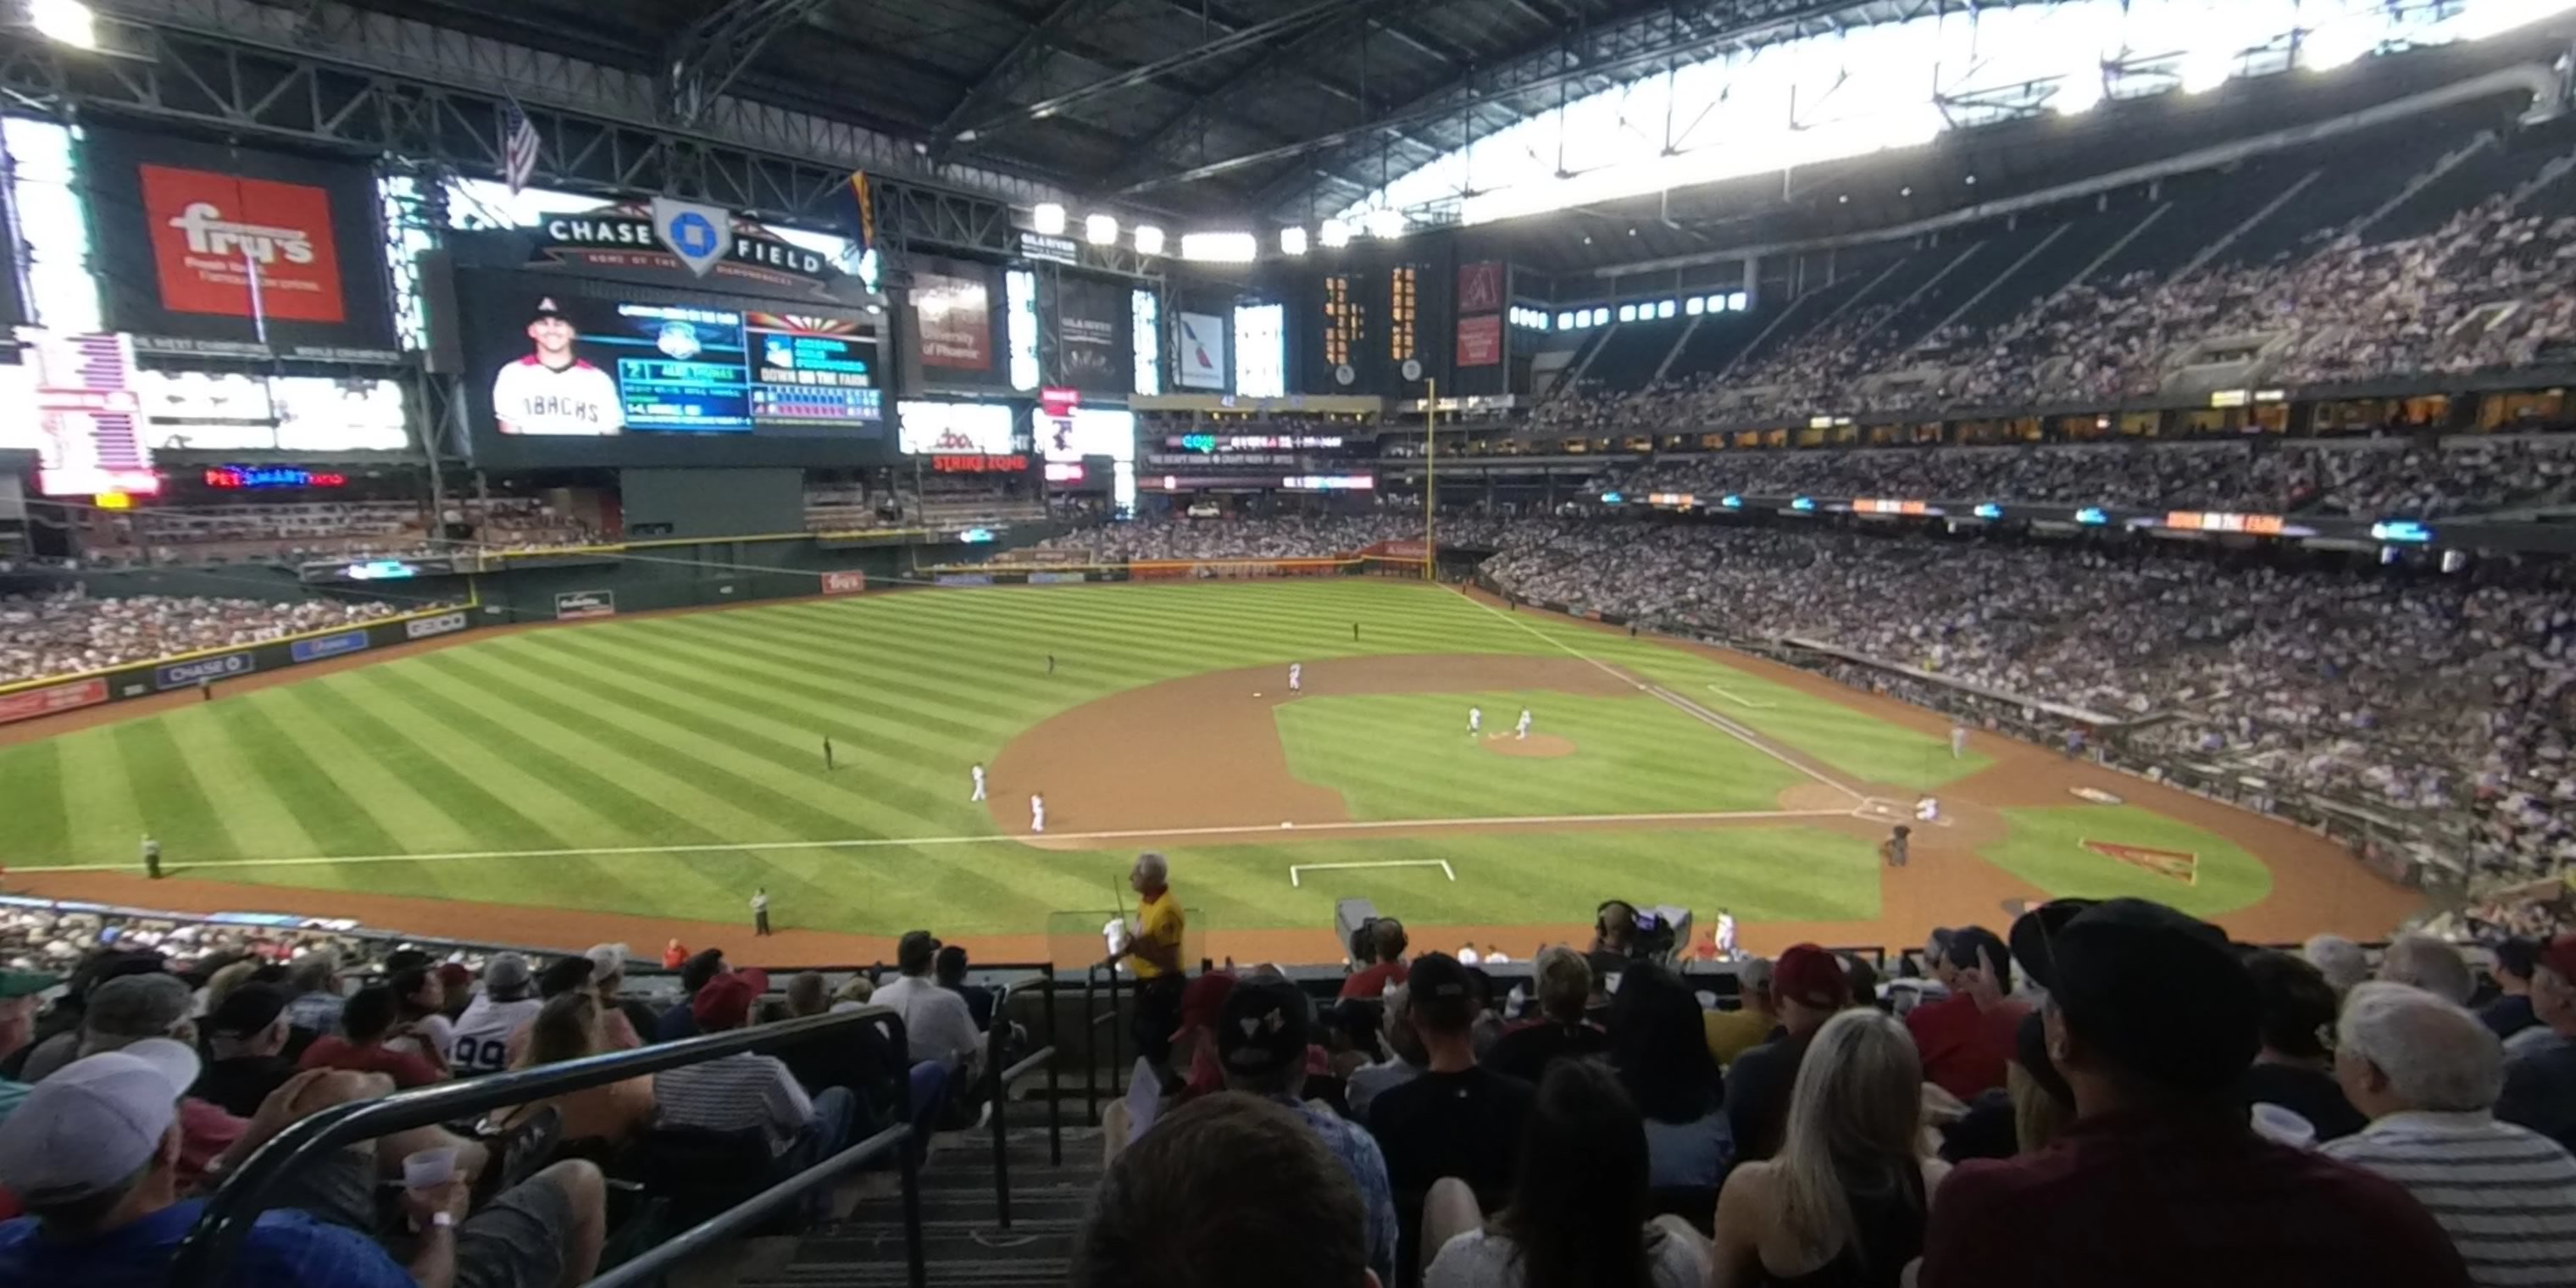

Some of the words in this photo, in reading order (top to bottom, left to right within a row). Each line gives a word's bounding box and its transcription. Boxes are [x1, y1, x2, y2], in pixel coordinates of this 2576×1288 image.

[169, 202, 314, 264] fry's
[549, 219, 652, 244] CHASE
[737, 240, 821, 273] FIELD
[588, 254, 625, 264] HOME
[631, 256, 647, 265] OF
[654, 256, 677, 268] THE
[922, 341, 935, 355] of
[933, 455, 985, 472] STRIKE
[987, 455, 1028, 471] ZONE
[410, 615, 464, 636] GEICO
[170, 660, 224, 681] CHASE
[456, 1035, 505, 1071] 99
